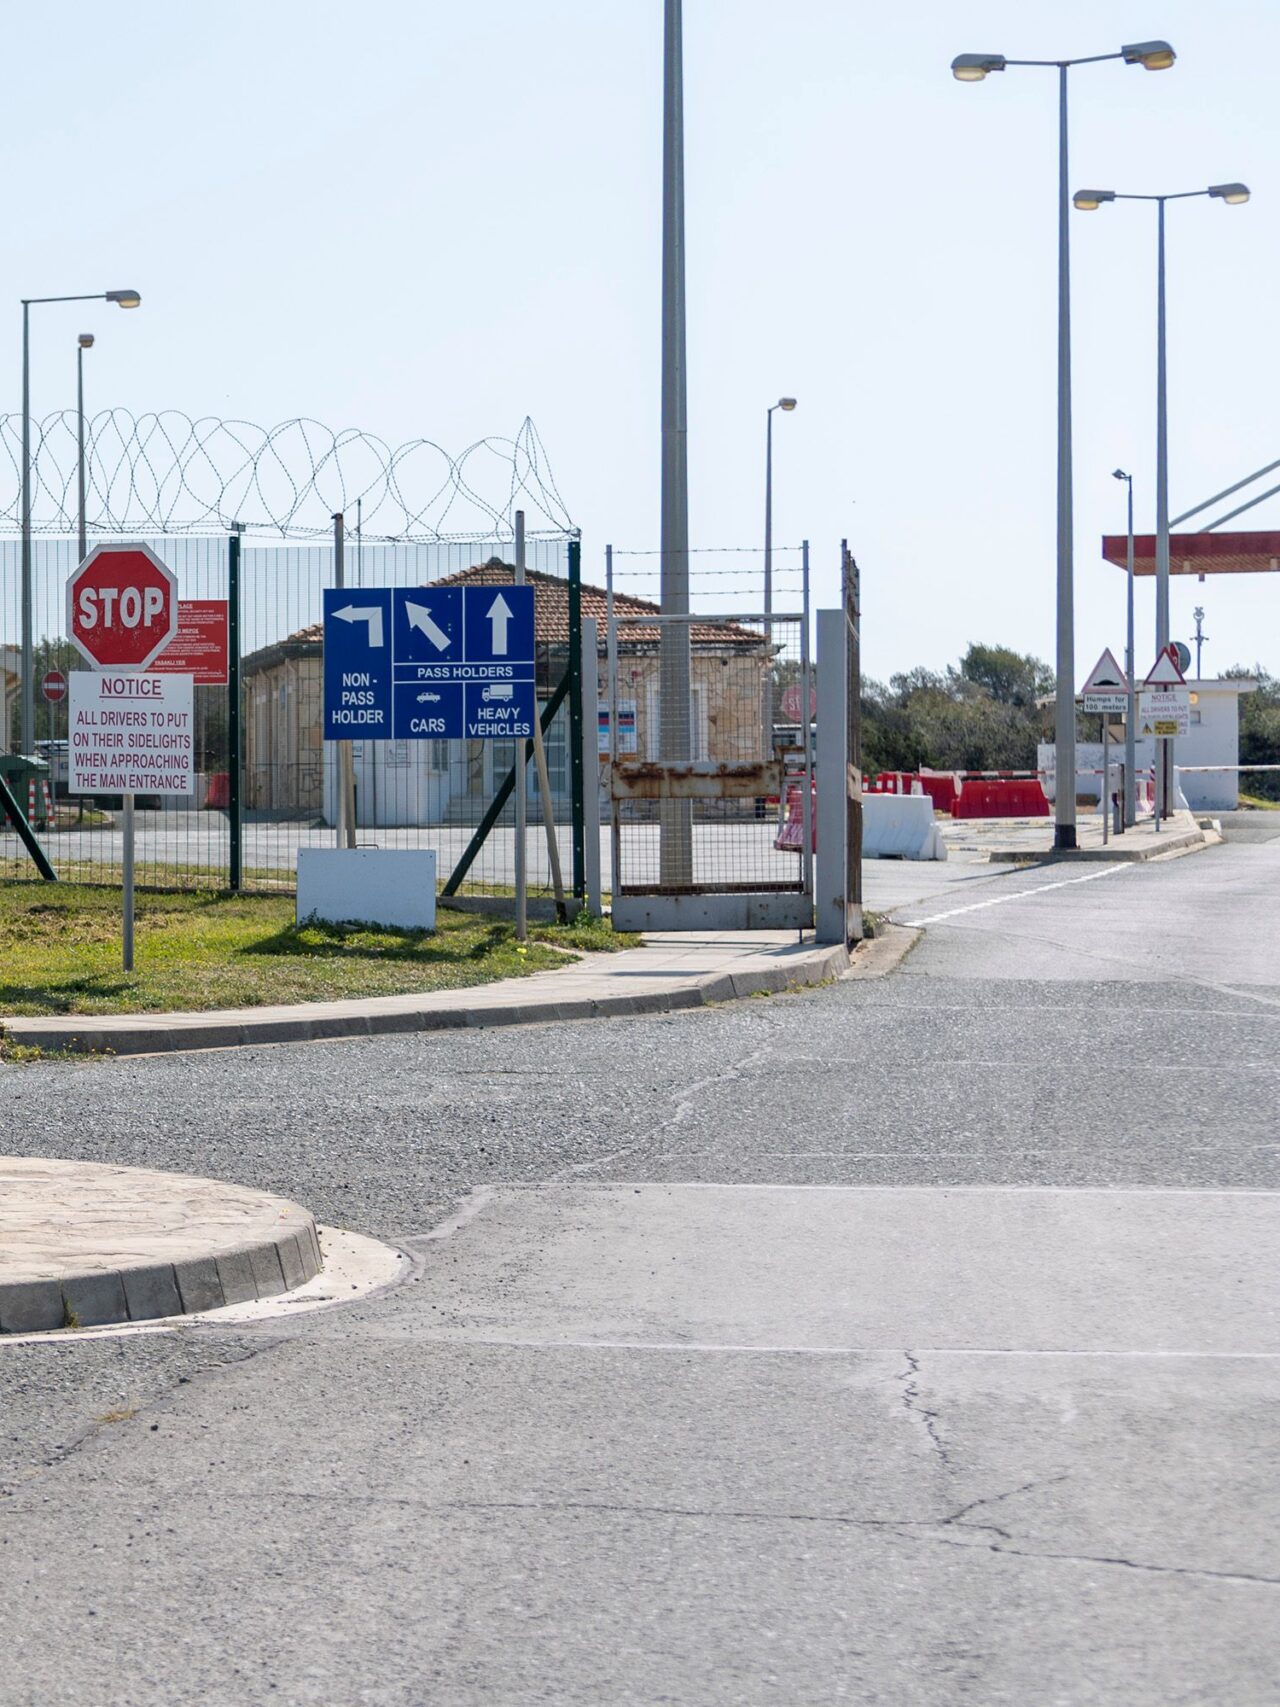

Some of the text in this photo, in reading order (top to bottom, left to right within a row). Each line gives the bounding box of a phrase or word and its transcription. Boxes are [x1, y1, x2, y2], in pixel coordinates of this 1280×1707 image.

[78, 586, 164, 630] STOP
[342, 672, 370, 687] NON
[417, 666, 514, 678] PASS HOLDERS
[101, 677, 162, 695] NOTICE
[341, 691, 375, 706] PASS
[76, 710, 189, 728] ALL DRIVERS TO PUT
[332, 709, 384, 724] HOLDER
[477, 707, 521, 720] HEAVY
[410, 718, 446, 733] CARS
[468, 722, 531, 736] VEHICLES
[72, 731, 191, 750] ON THEIR SIDELIGHTS
[74, 752, 189, 770] WHEN APPROACHING
[75, 772, 187, 790] THE MAIN ENTRANCE
